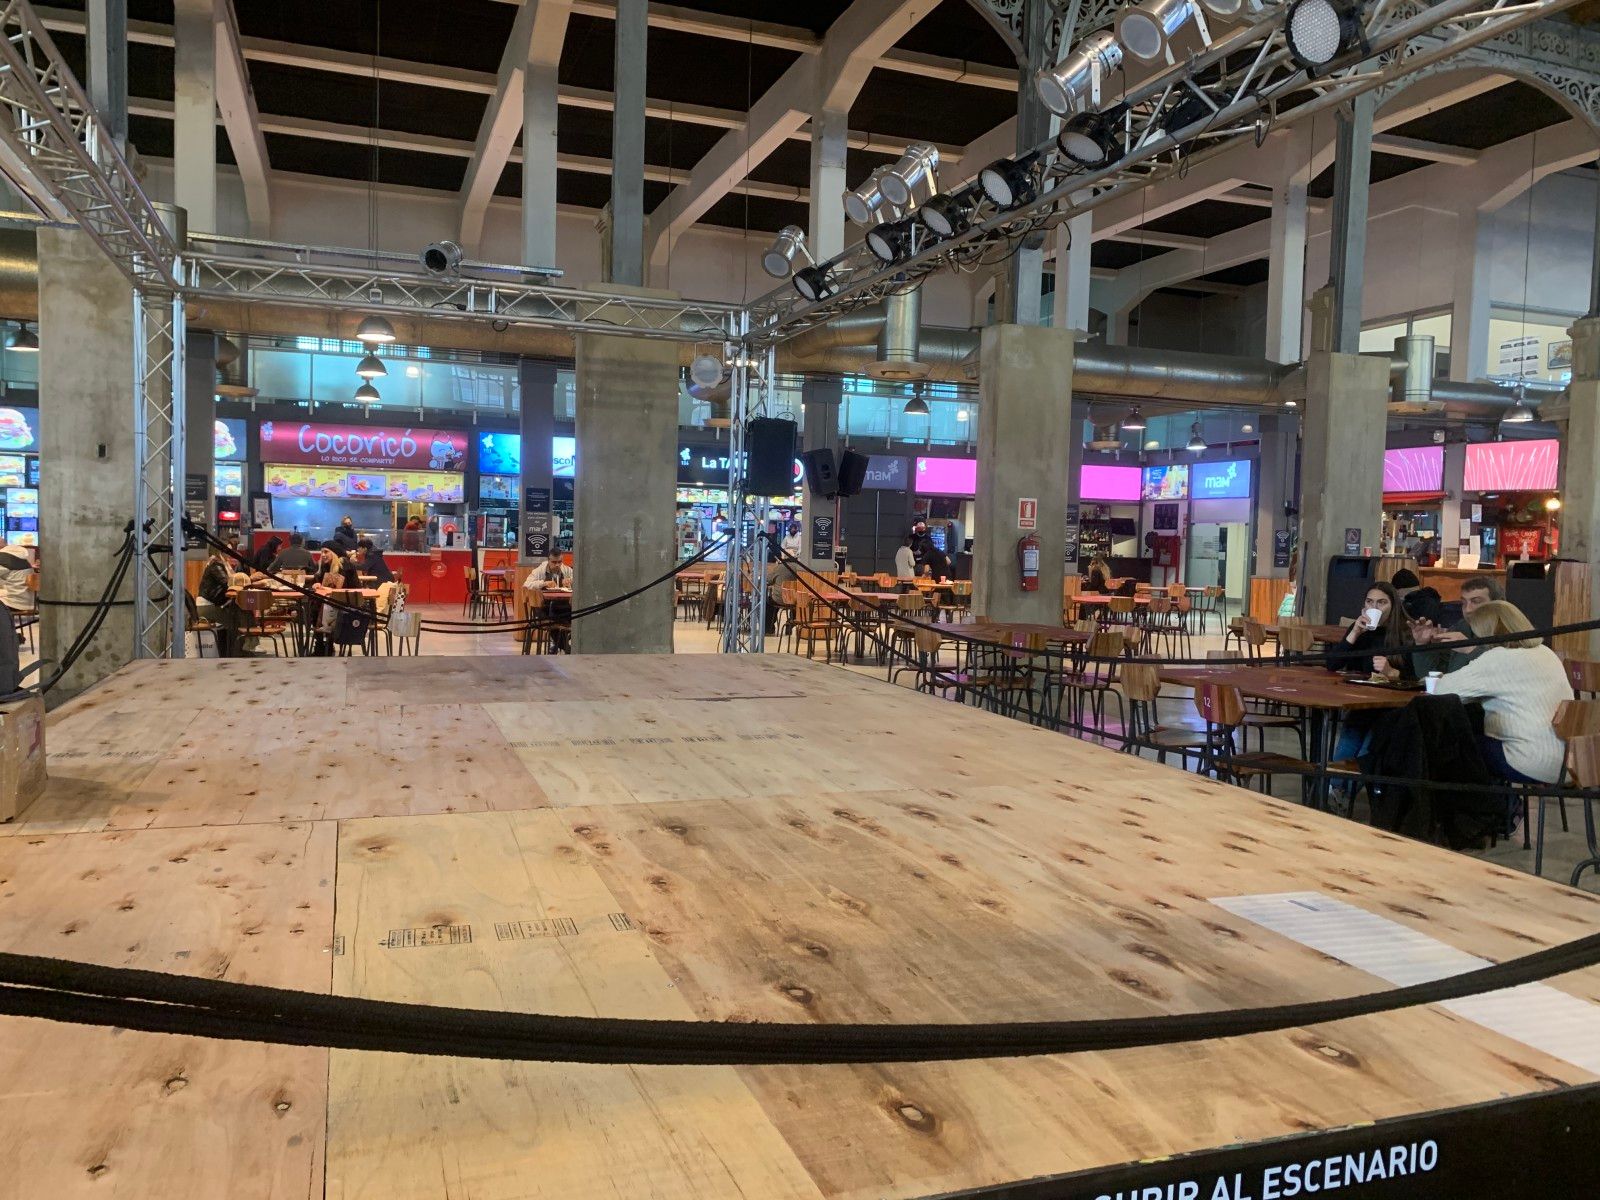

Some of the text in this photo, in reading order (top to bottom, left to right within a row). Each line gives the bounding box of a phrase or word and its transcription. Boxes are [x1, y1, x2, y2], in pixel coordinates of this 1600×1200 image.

[298, 424, 417, 457] Cocoricó
[701, 456, 717, 469] La
[1204, 696, 1211, 708] 12
[1211, 1173, 1252, 1200] AL
[1263, 1140, 1438, 1200] ESCENARIO
